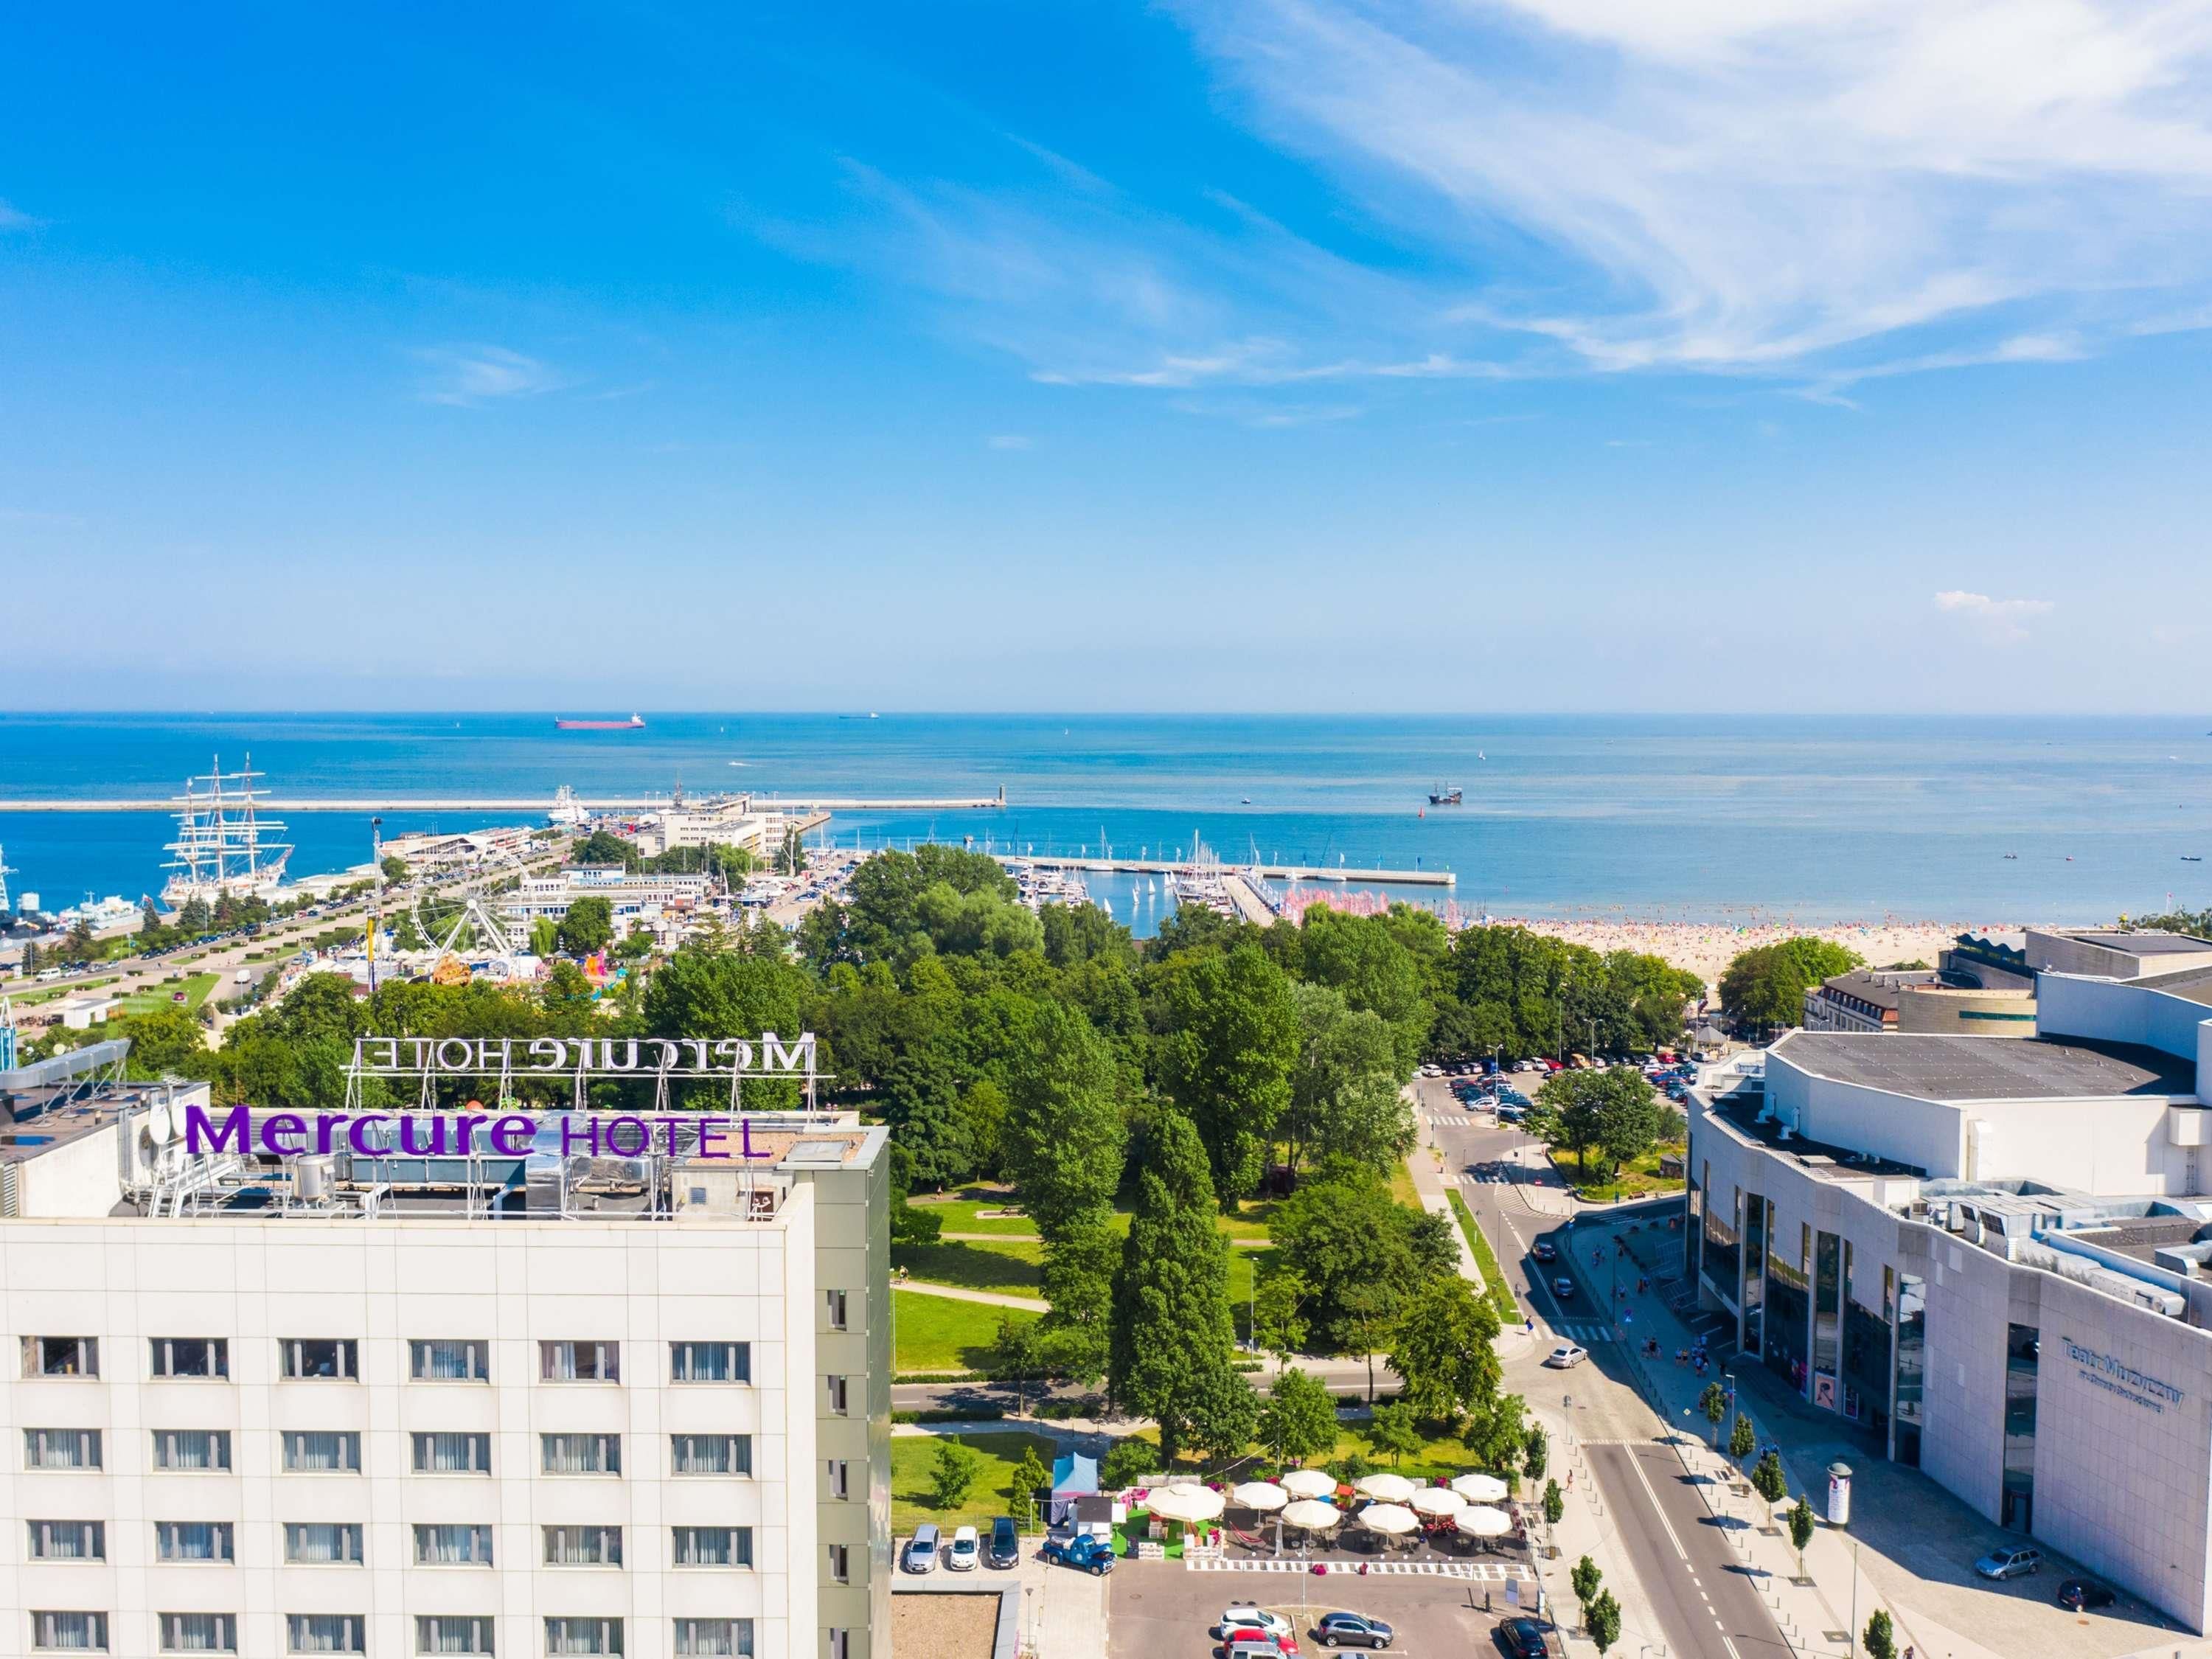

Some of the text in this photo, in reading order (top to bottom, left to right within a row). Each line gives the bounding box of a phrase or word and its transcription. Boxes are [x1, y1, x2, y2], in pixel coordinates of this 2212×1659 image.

[186, 1105, 771, 1158] Mercure HOTEL
[2060, 1336, 2101, 1370] Teatr
[2104, 1354, 2184, 1410] Muzyczny
